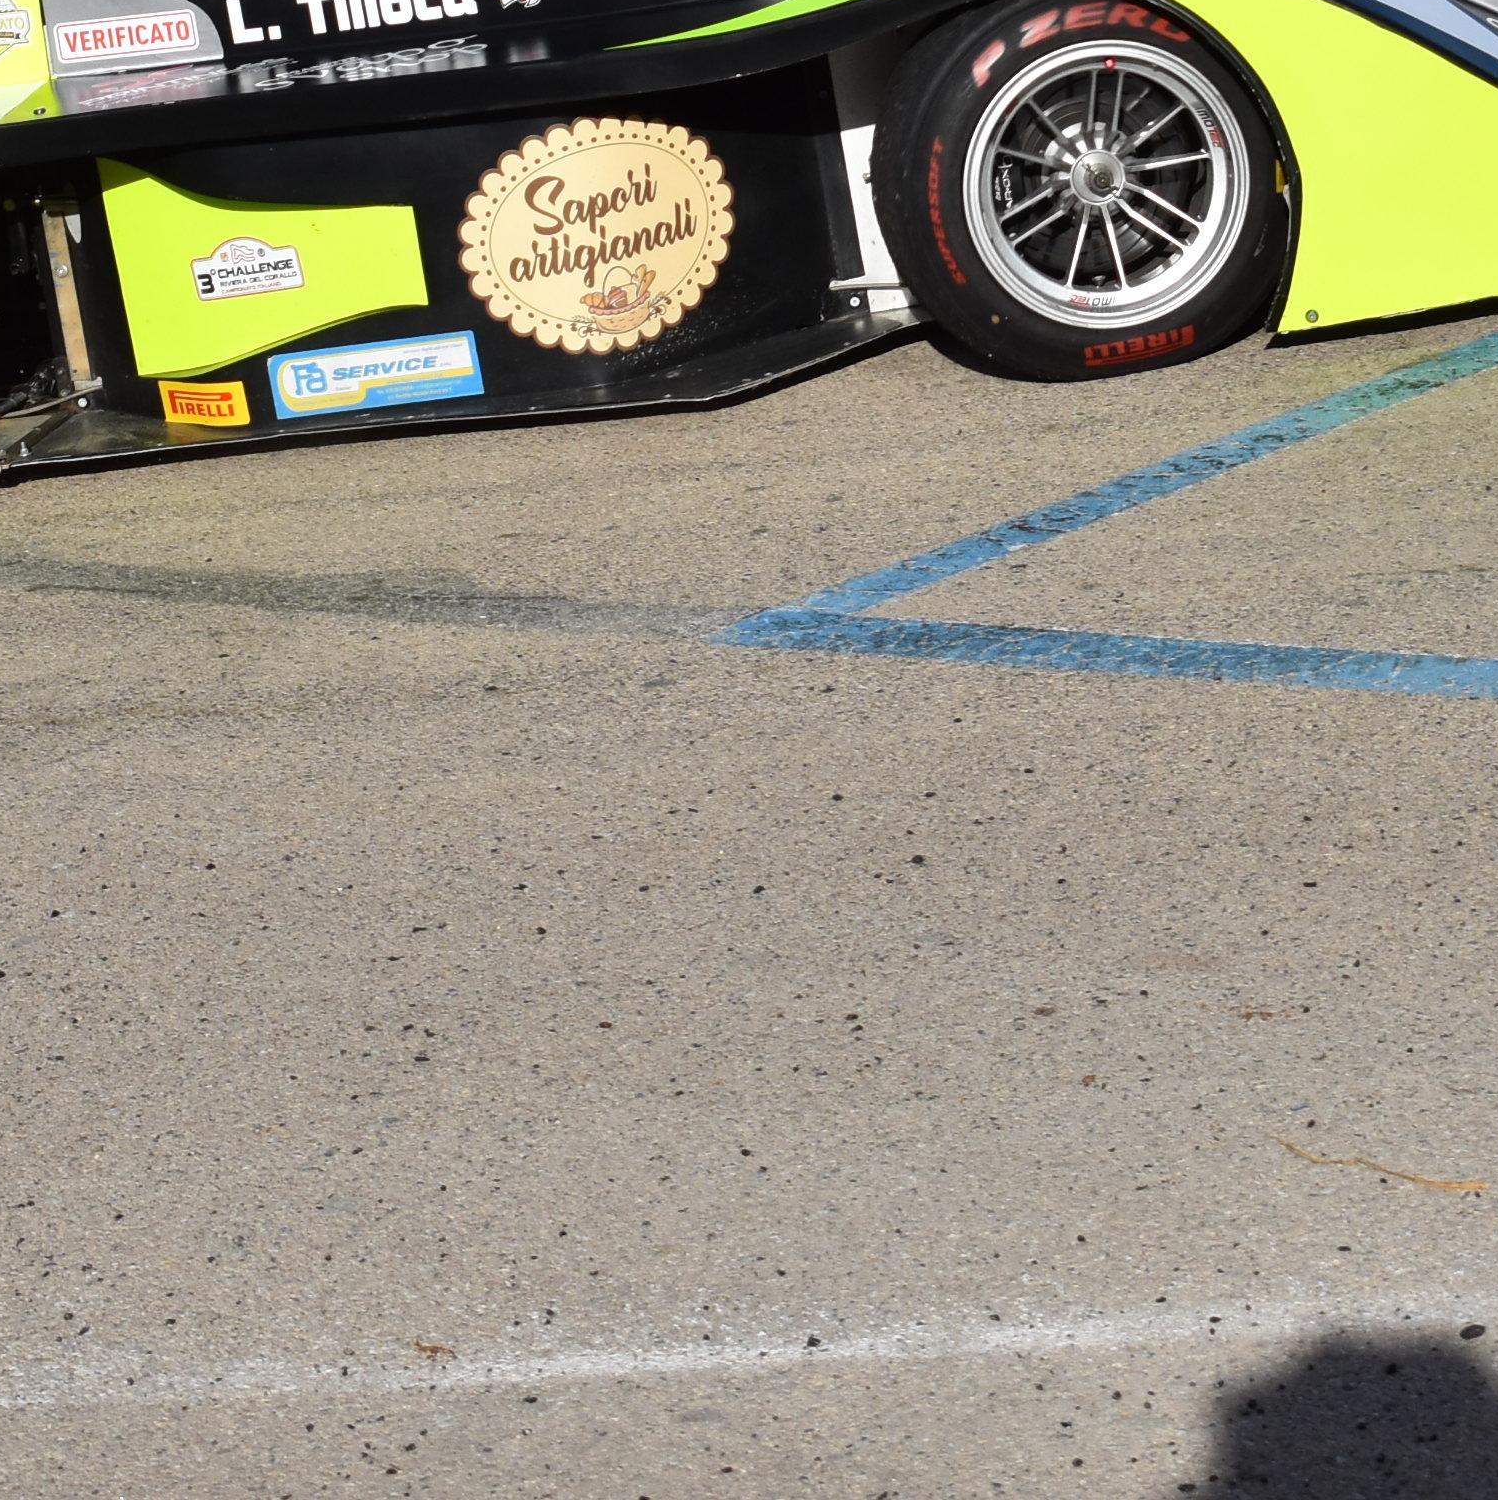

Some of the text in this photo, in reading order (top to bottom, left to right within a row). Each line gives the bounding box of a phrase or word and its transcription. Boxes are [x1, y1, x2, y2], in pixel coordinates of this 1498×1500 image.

[64, 21, 190, 53] VERIFICATO
[524, 162, 657, 236] Sapori
[509, 197, 697, 288] artigianali
[217, 258, 294, 279] CHALLENGE
[219, 278, 248, 288] RIVIERA
[264, 270, 298, 281] CORALLO
[1083, 324, 1195, 368] PIRELLI
[332, 355, 439, 381] SERVICE
[167, 389, 235, 418] PIRELLI
